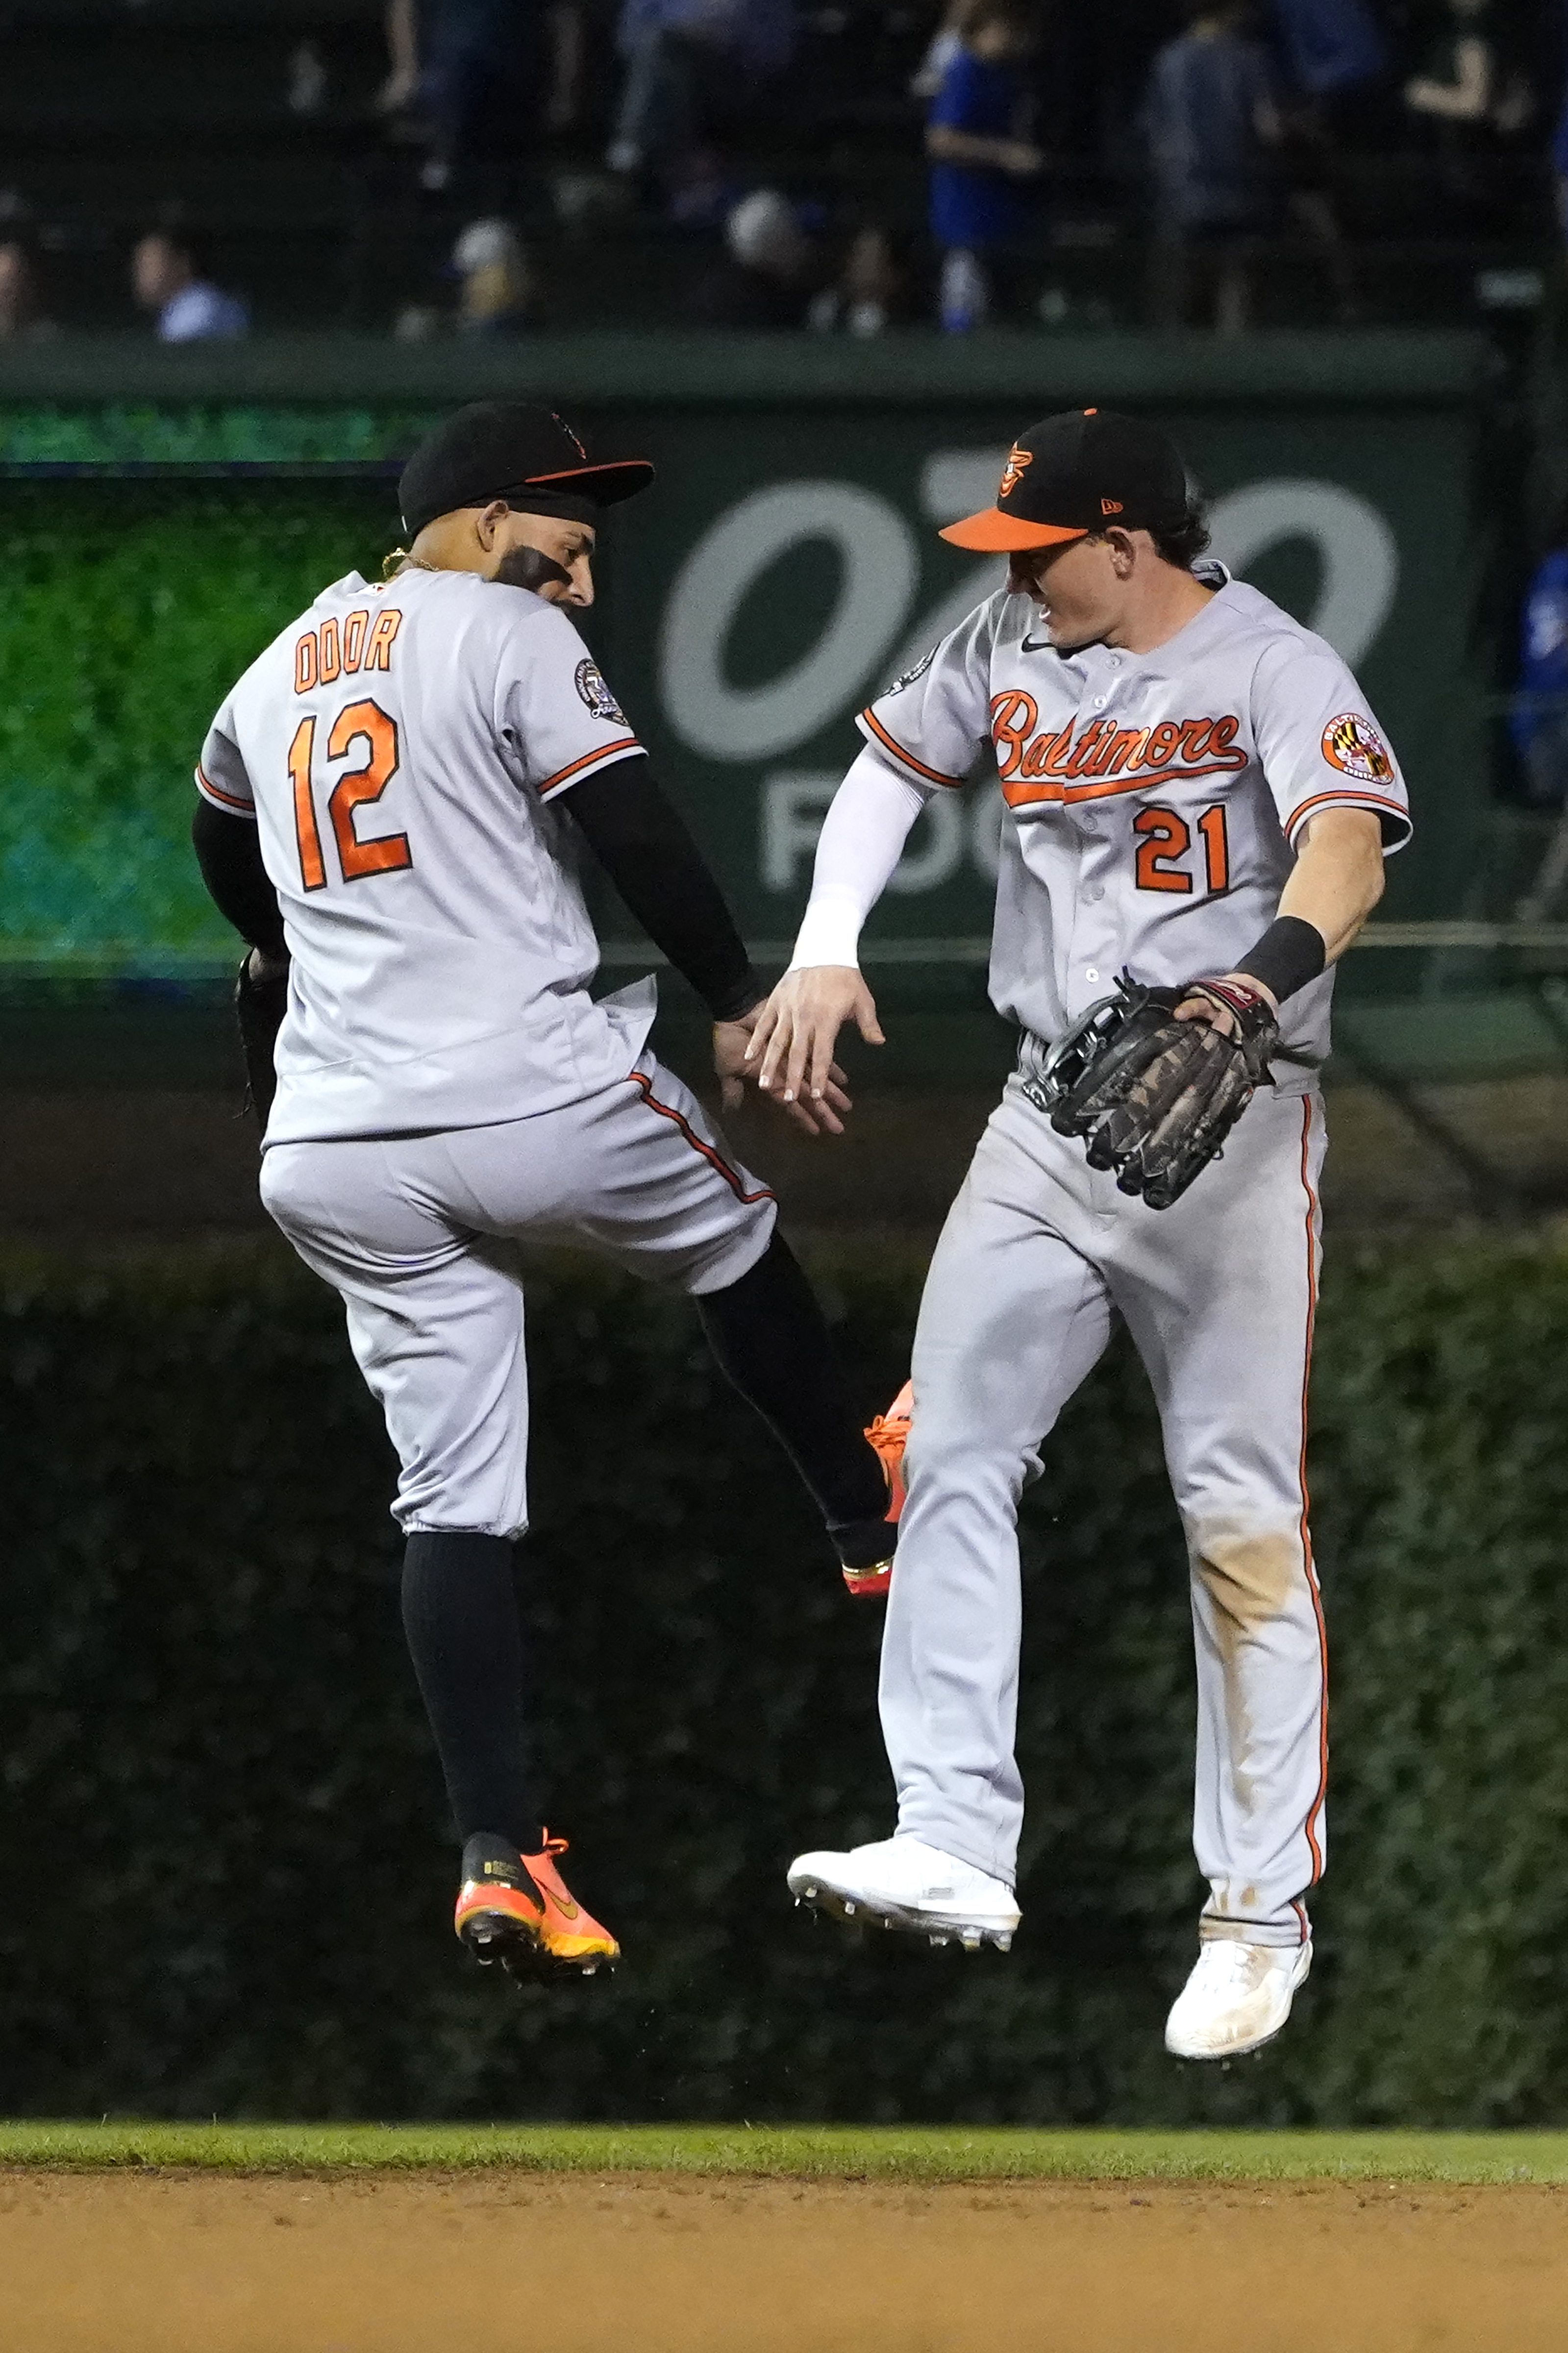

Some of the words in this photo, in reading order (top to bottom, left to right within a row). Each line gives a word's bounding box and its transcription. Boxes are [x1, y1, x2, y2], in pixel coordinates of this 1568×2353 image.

[294, 609, 402, 695] ODOR
[659, 450, 1398, 764] OO
[990, 689, 1248, 779] Baltimore
[288, 698, 413, 892] 12
[1133, 804, 1229, 894] 21
